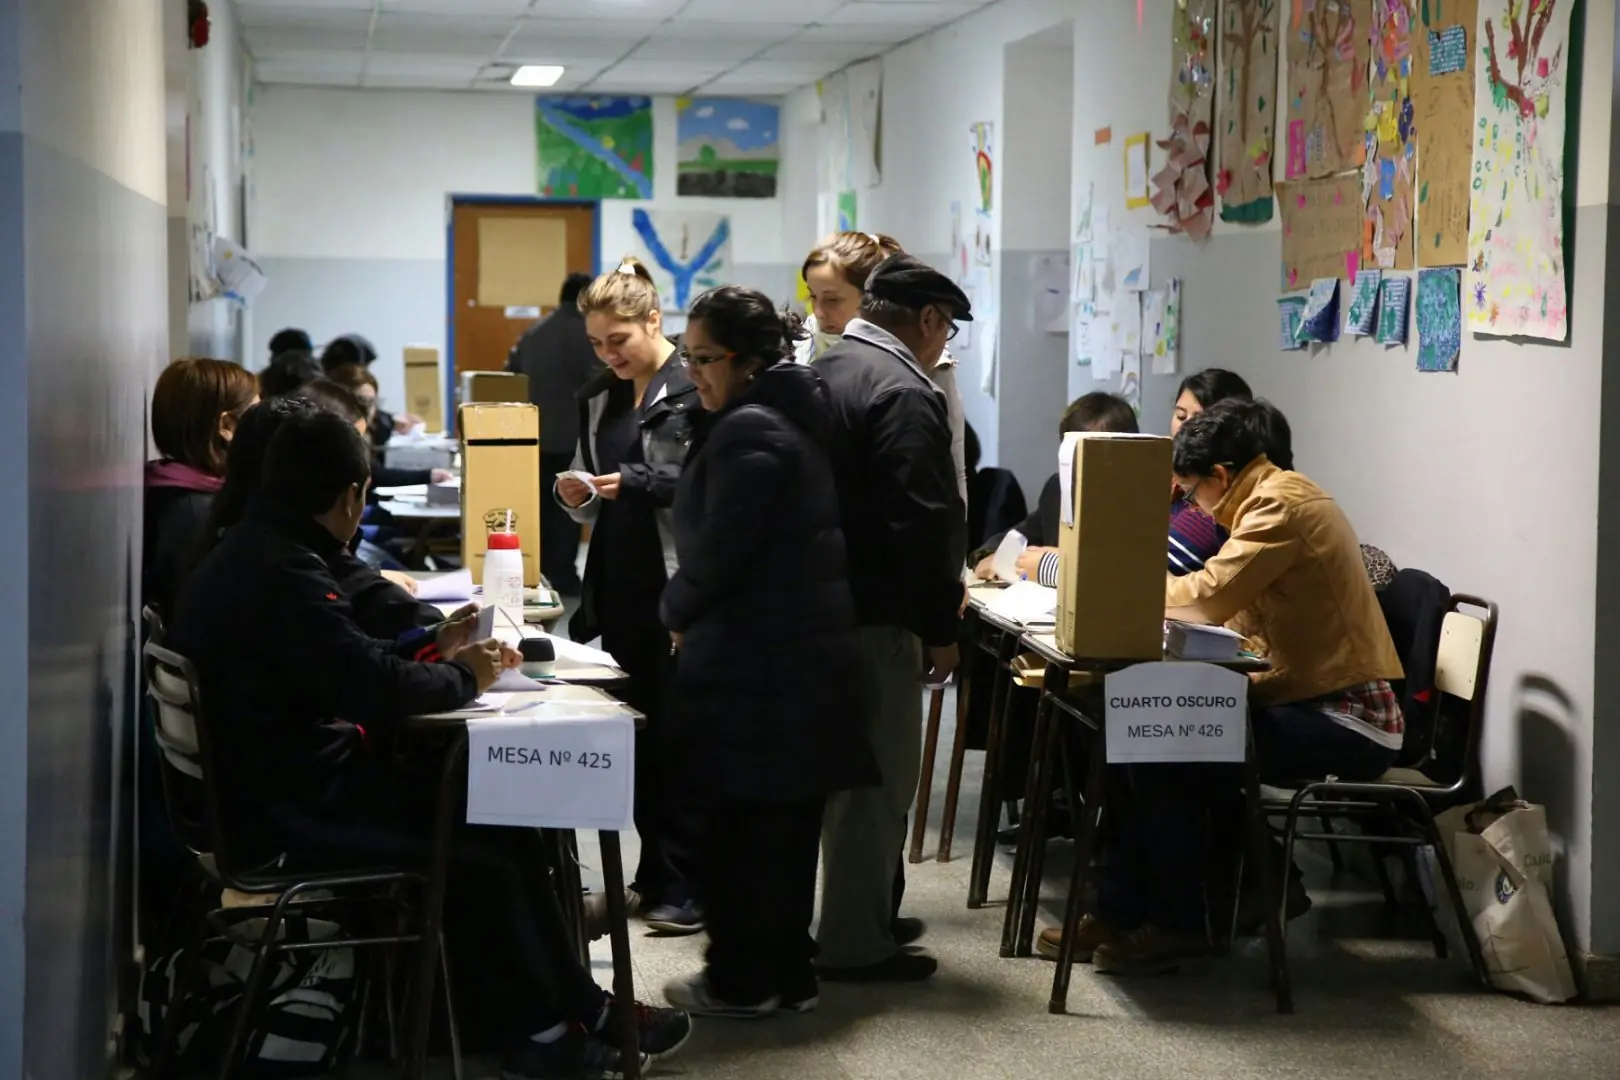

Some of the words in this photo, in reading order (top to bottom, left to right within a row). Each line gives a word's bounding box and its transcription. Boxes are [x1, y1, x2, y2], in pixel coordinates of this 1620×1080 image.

[1110, 696, 1172, 709] CUARTO
[1176, 695, 1237, 708] OSCURO
[1128, 724, 1174, 738] MESA
[1179, 724, 1195, 737] Nº
[1198, 724, 1223, 737] 426
[488, 746, 542, 765] MESA
[550, 750, 572, 766] Nº
[578, 752, 612, 769] 425
